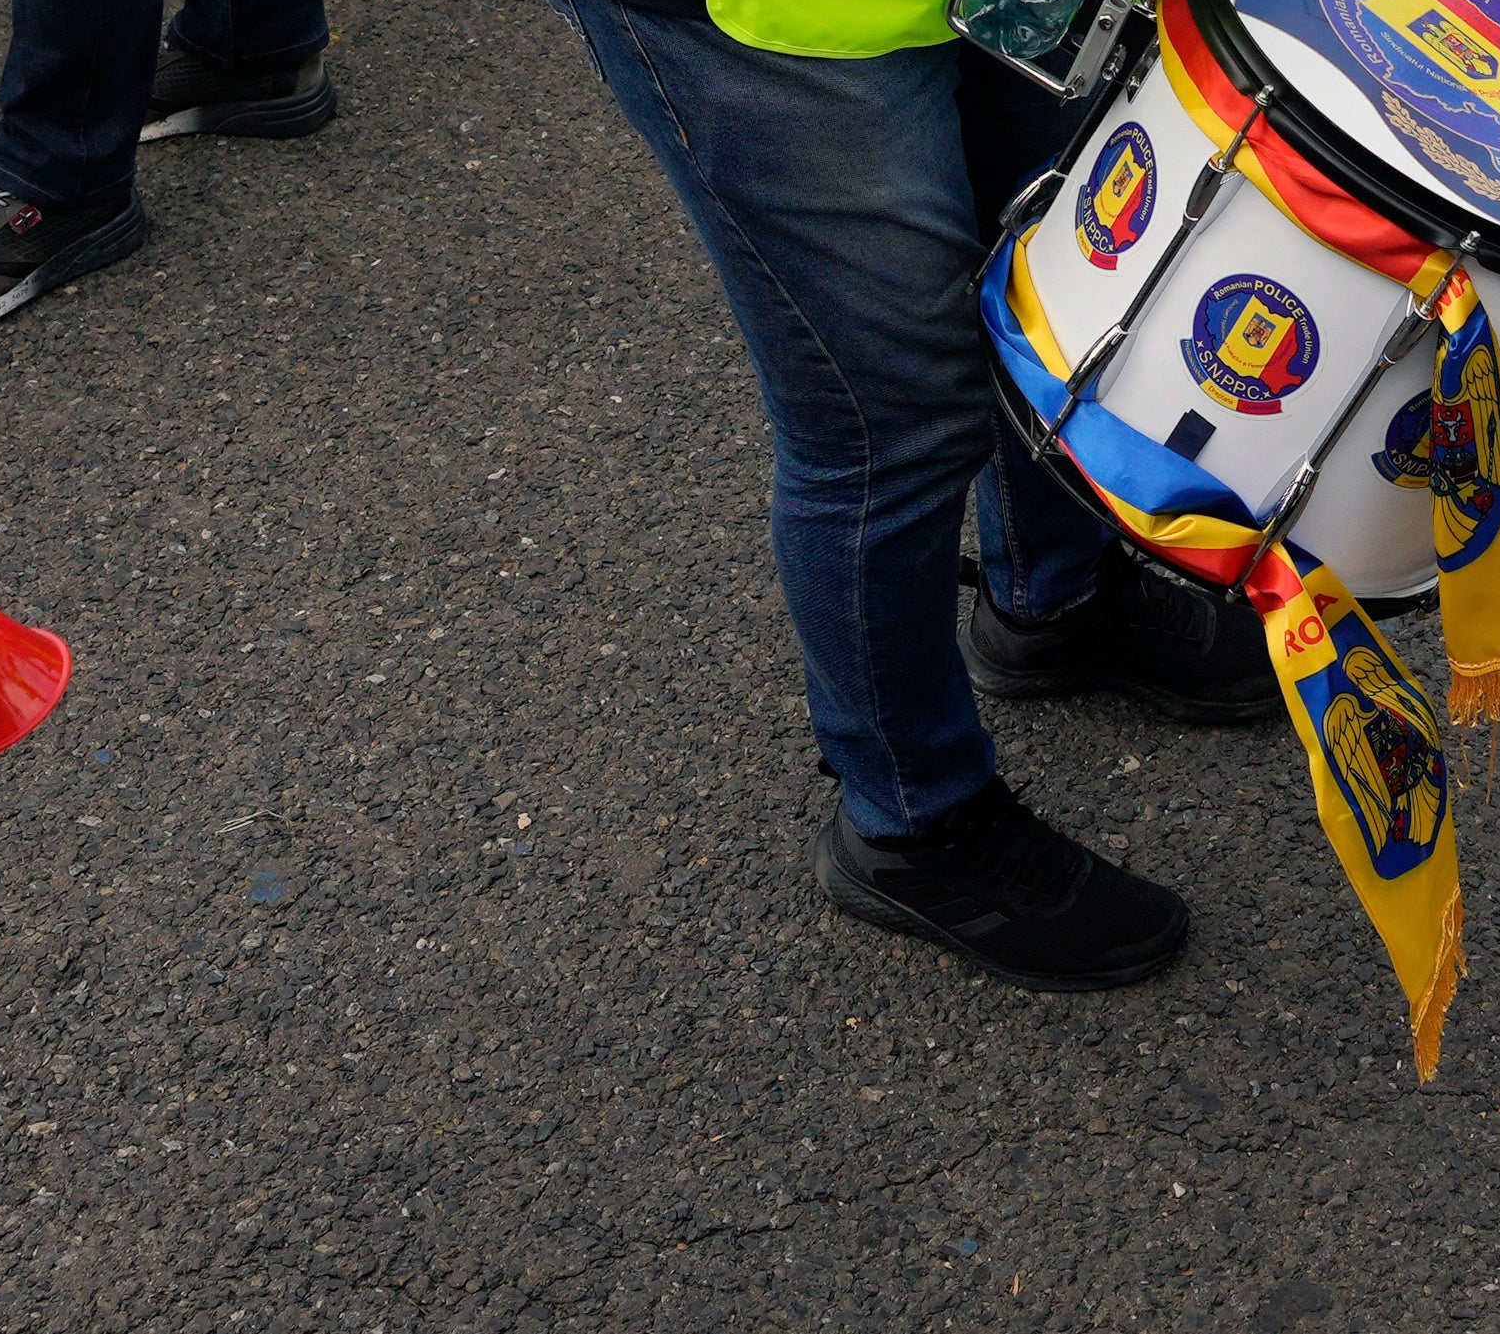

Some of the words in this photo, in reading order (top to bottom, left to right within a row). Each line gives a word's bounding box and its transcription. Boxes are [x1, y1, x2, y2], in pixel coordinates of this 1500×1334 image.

[1131, 127, 1154, 173] POLICE
[1213, 280, 1253, 300] Romanian
[1254, 279, 1305, 320] POLICE
[1299, 317, 1312, 341] Trade
[1301, 340, 1314, 365] Union
